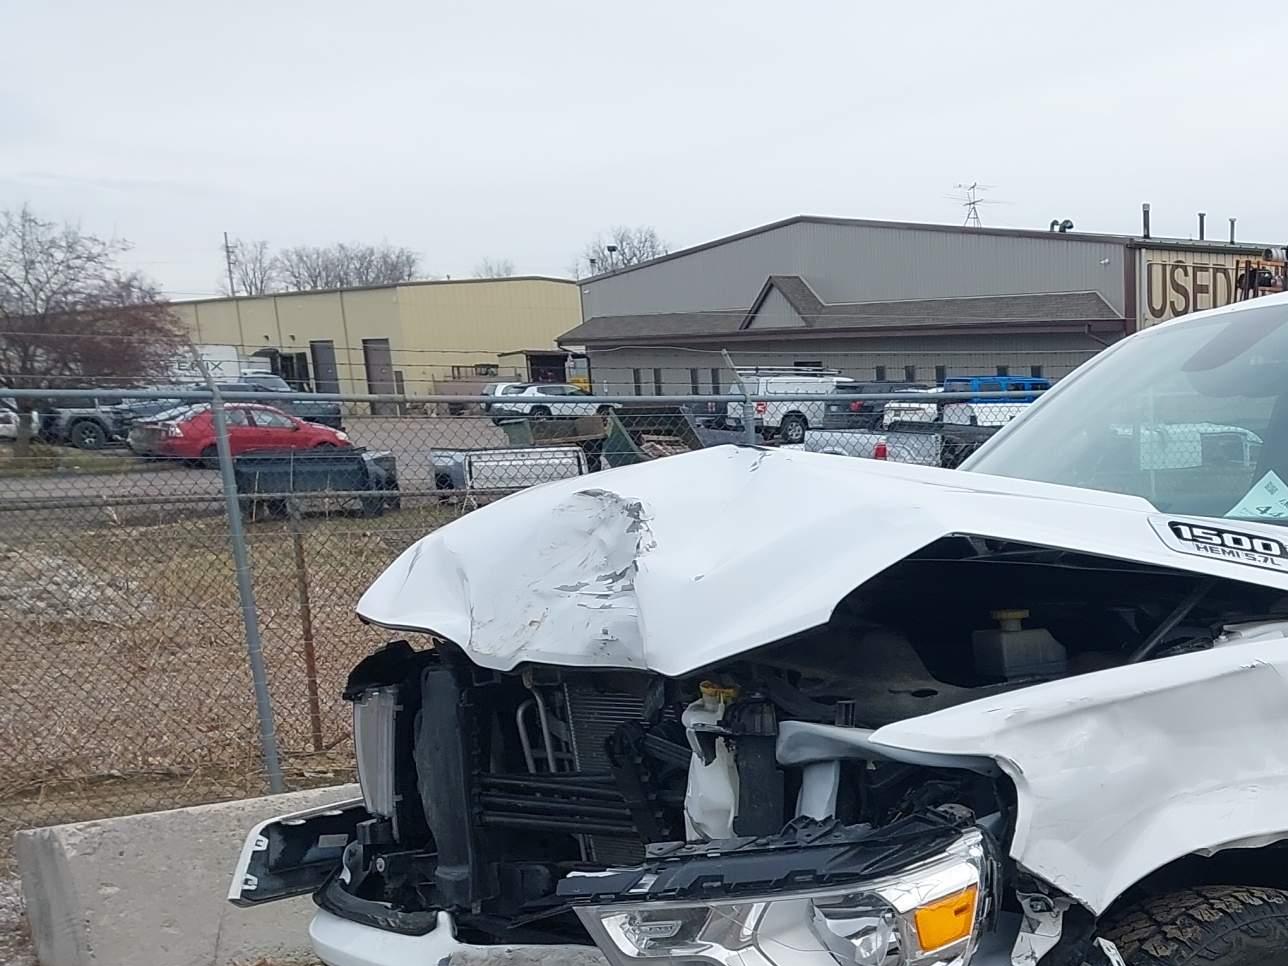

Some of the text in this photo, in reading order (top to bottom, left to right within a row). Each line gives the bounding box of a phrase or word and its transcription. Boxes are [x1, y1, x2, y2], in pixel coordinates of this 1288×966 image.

[1146, 260, 1232, 318] USED
[1173, 524, 1281, 556] 1500
[1195, 543, 1281, 566] HEMI 5.7L
